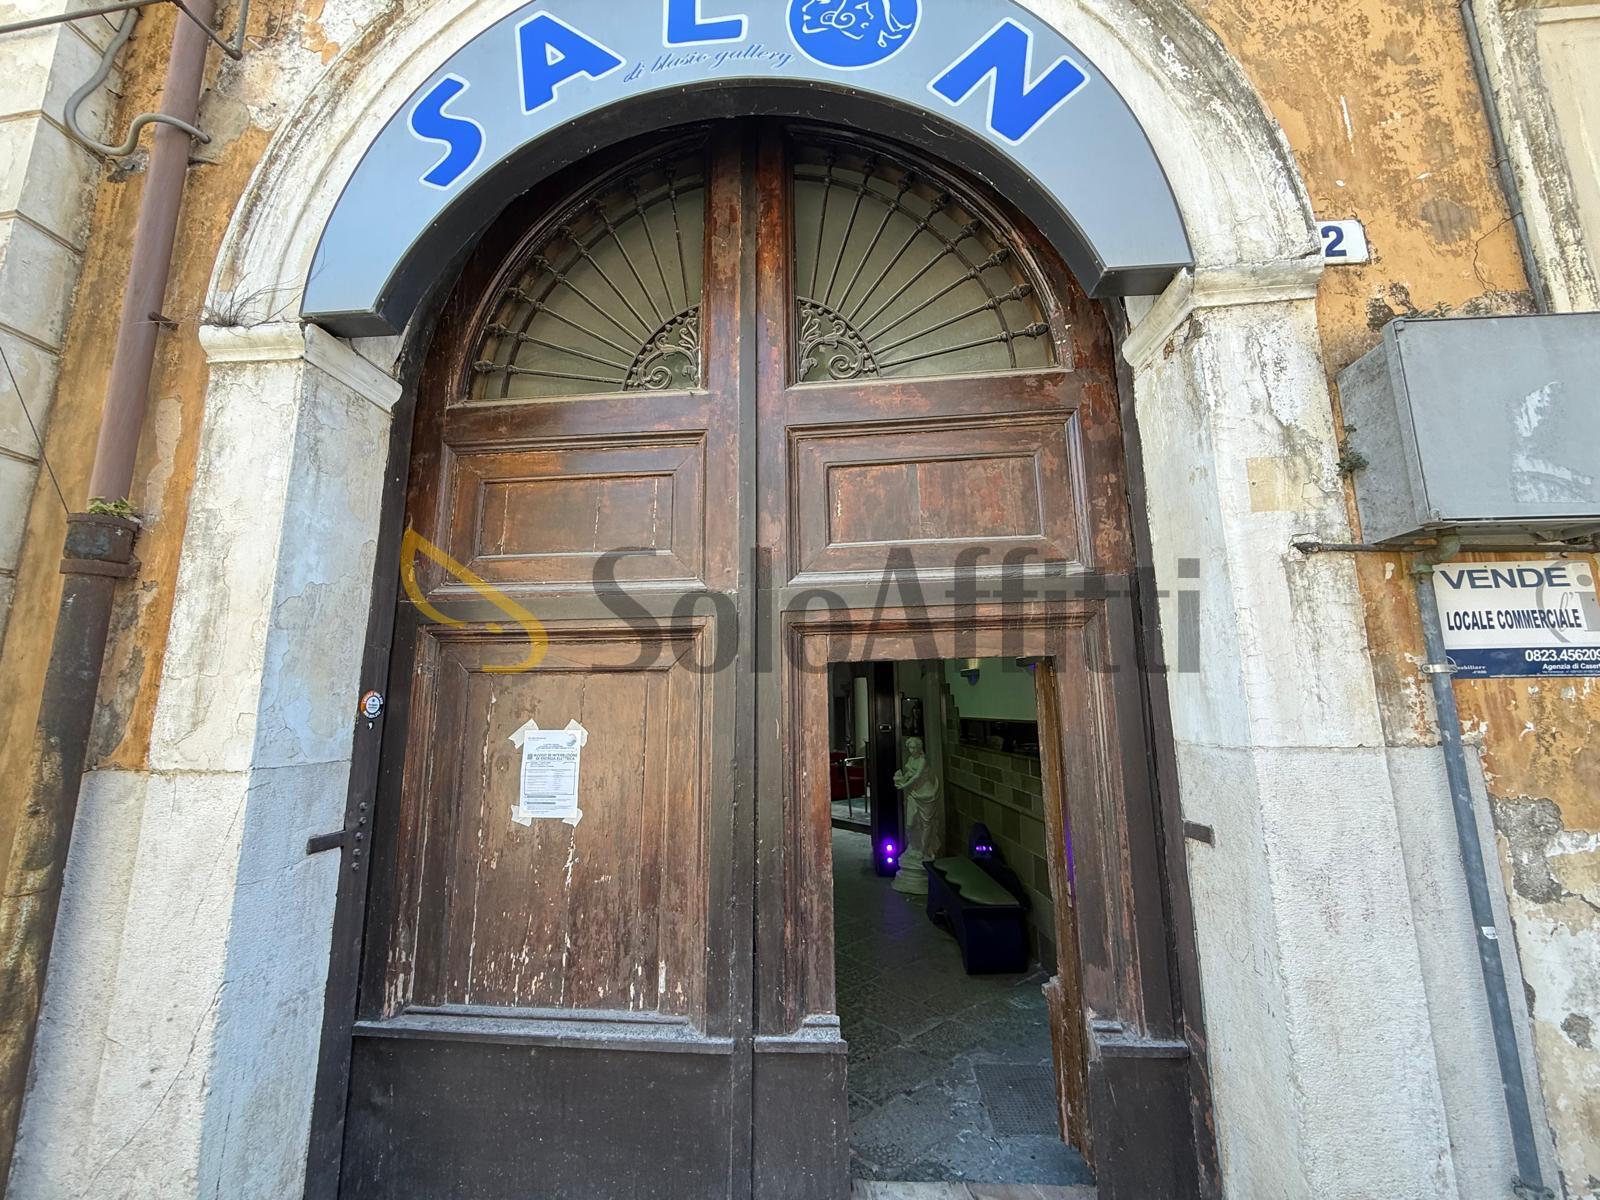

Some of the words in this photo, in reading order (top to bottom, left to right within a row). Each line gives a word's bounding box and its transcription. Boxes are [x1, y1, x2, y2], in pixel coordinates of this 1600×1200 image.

[623, 62, 645, 83] di
[650, 53, 710, 73] blasio
[712, 44, 793, 69] gallery
[1440, 567, 1571, 590] VENDE
[1446, 610, 1495, 631] LOCALE
[1497, 608, 1583, 630] COMMERCIALE
[1542, 663, 1571, 671] Agenzia
